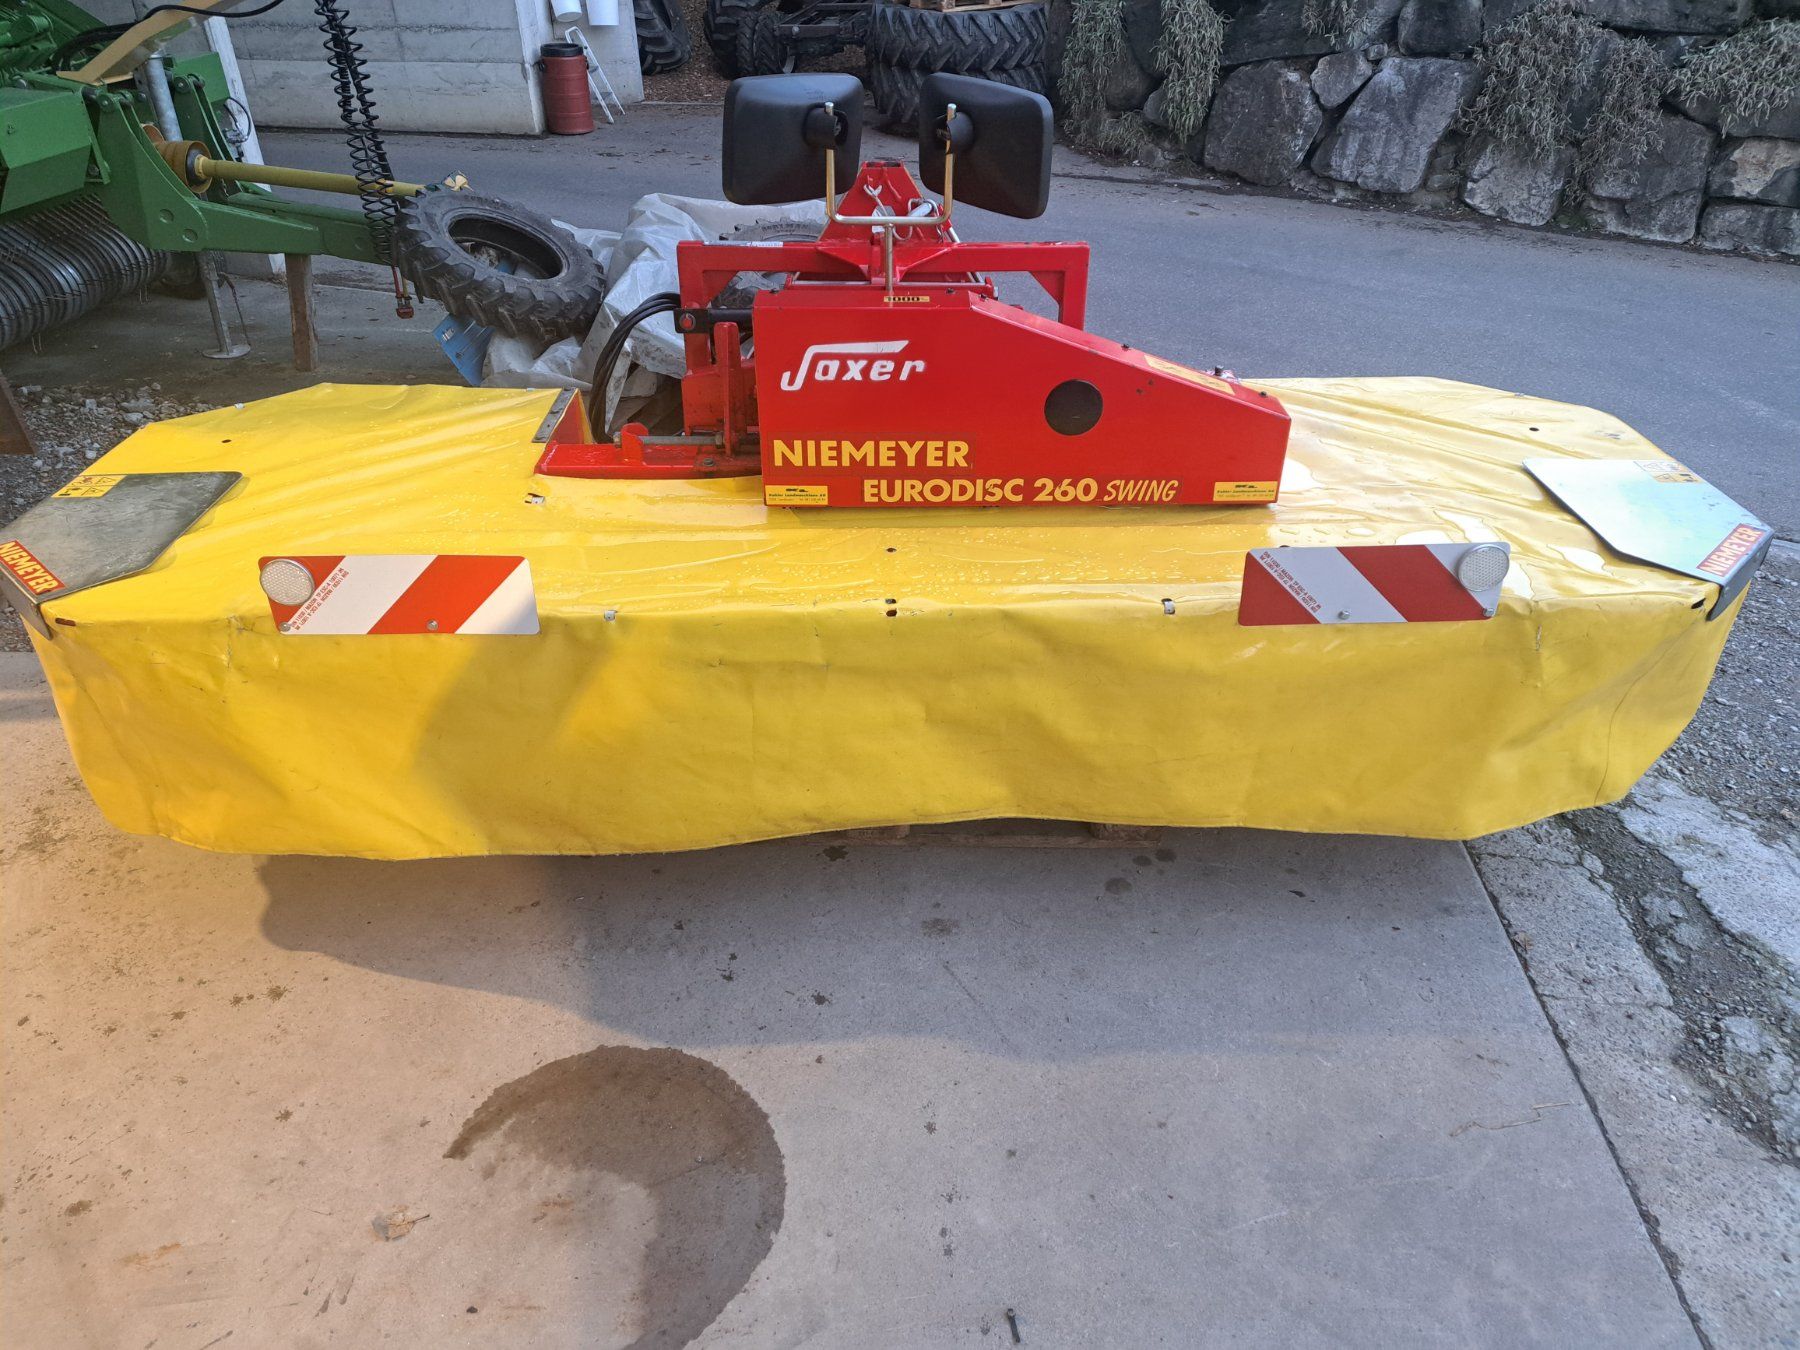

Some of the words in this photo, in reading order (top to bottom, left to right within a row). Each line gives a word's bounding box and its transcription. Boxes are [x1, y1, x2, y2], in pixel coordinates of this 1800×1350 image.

[773, 439, 969, 467] NIEMEYER
[863, 478, 1024, 502] EURODISC
[1033, 478, 1098, 502] 260
[1103, 479, 1179, 502] SWING
[0, 541, 59, 593] NIEMEYER
[1699, 527, 1761, 576] NIEMEYER
